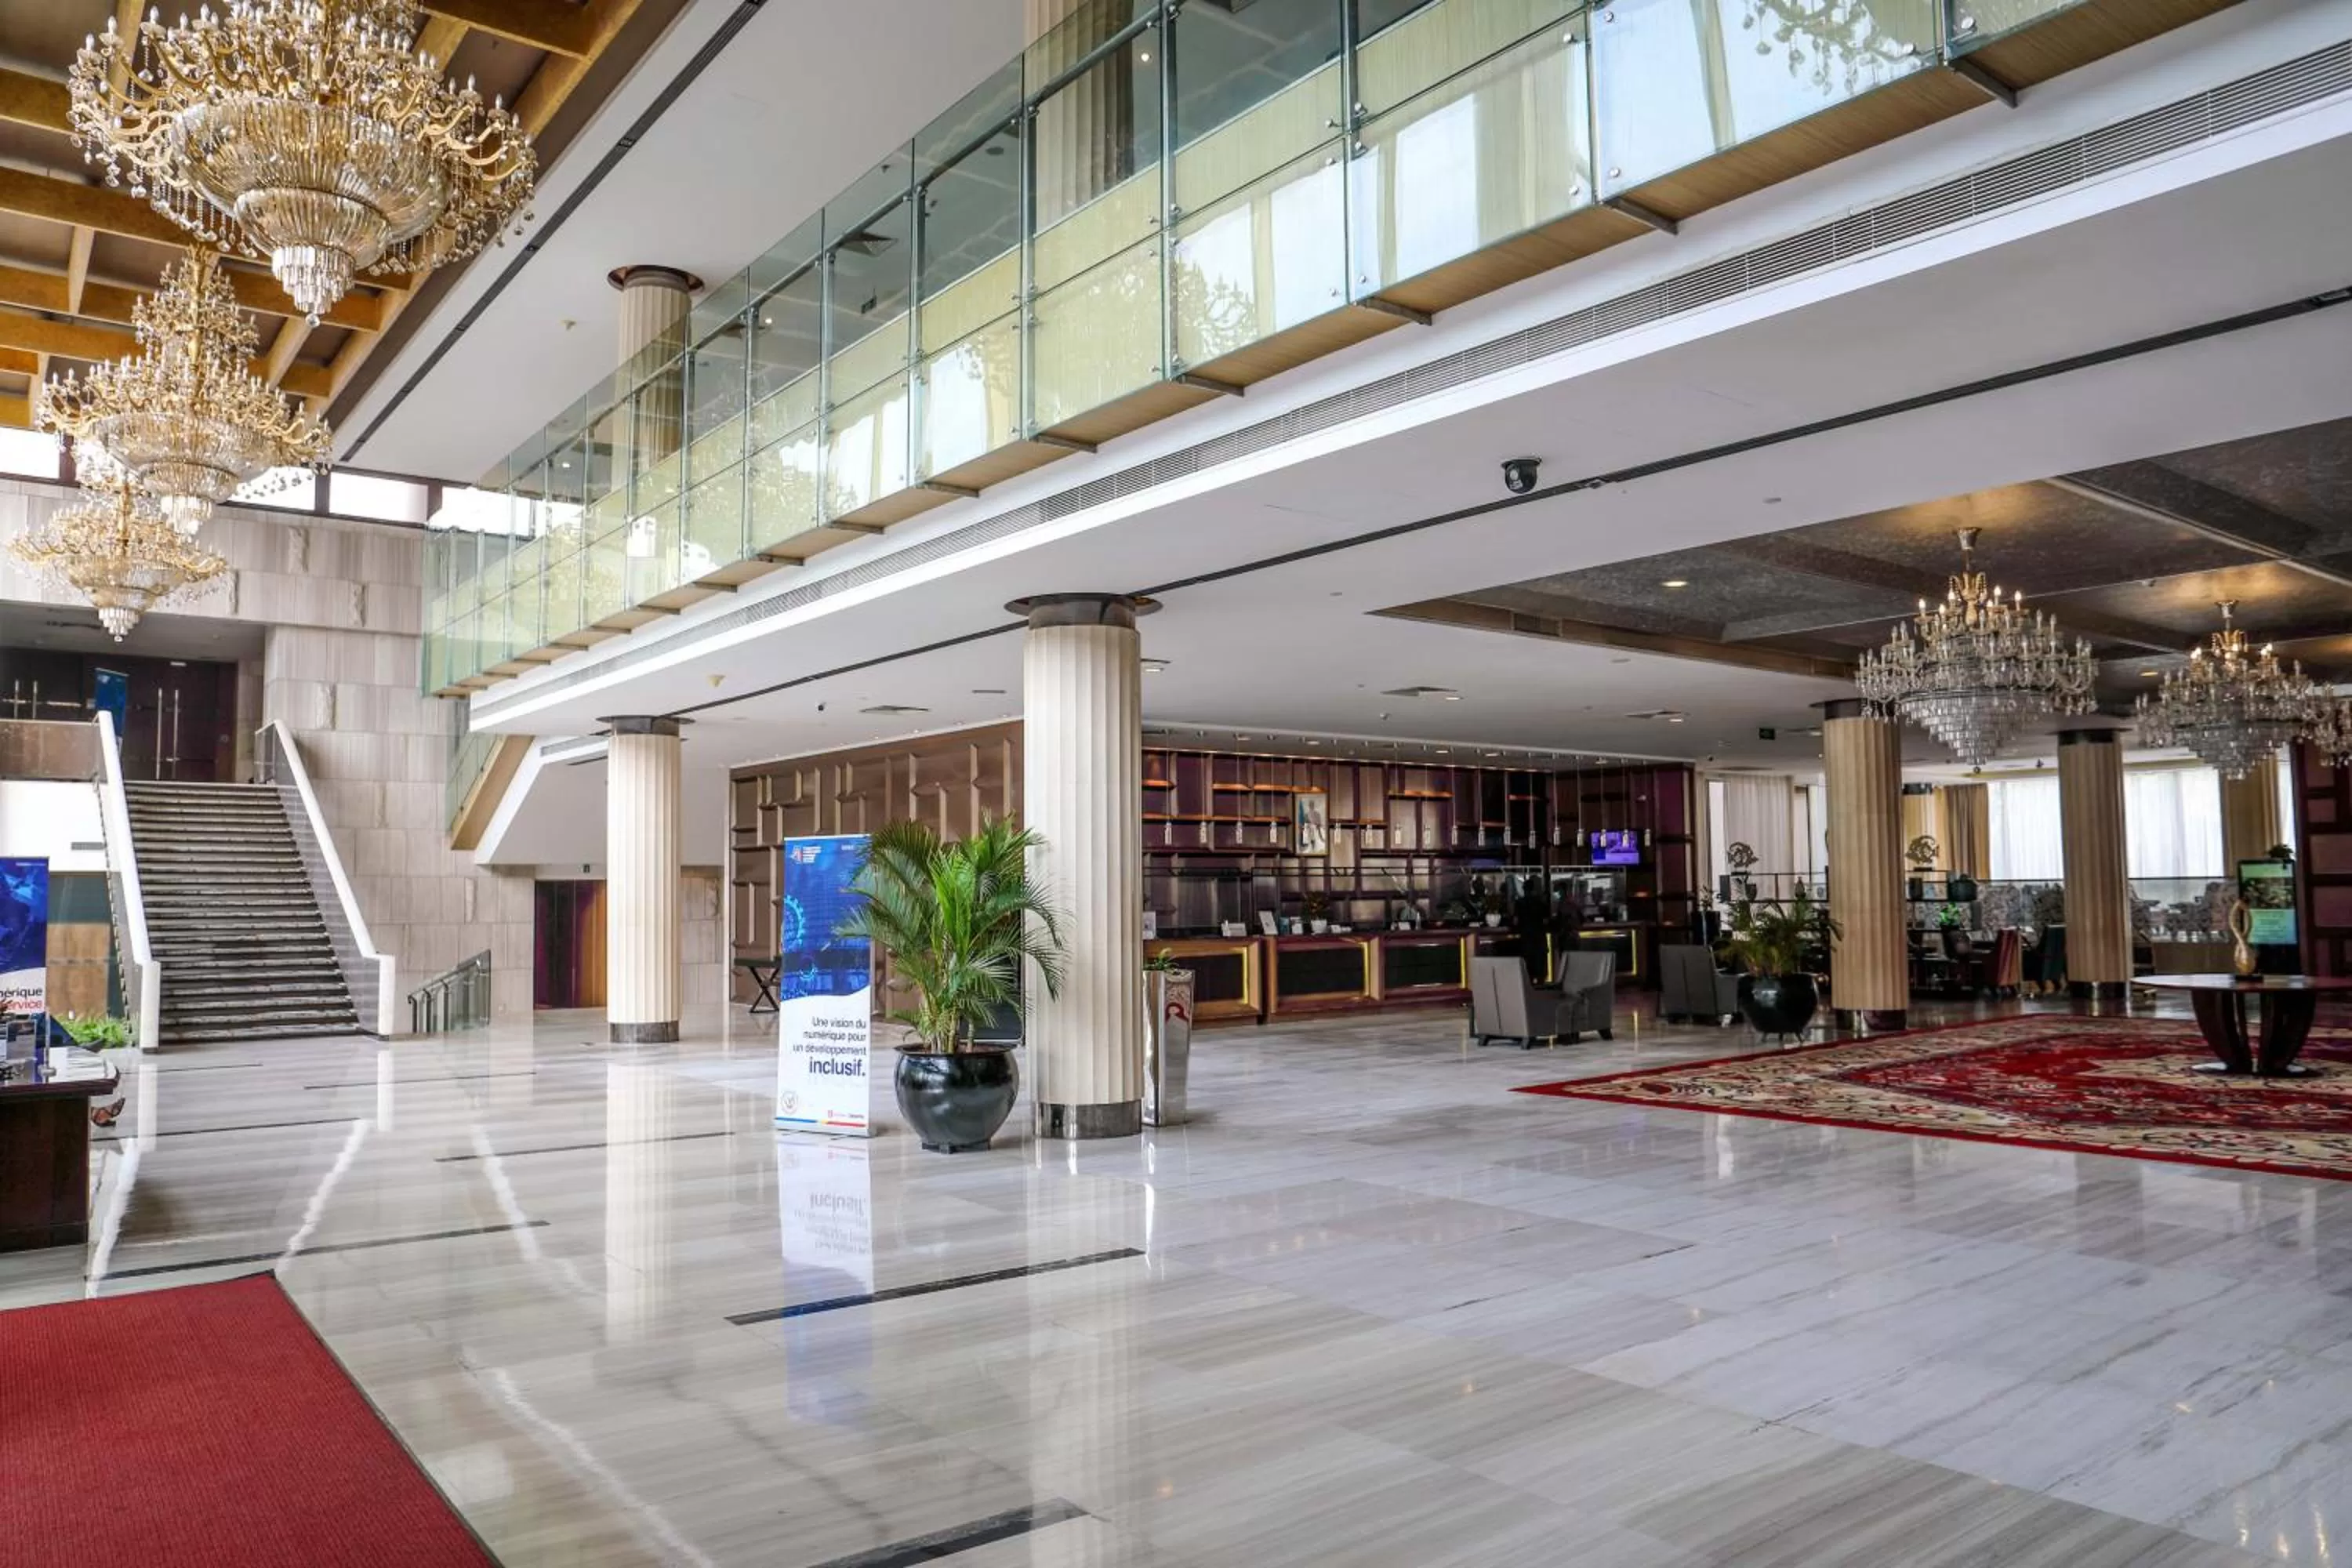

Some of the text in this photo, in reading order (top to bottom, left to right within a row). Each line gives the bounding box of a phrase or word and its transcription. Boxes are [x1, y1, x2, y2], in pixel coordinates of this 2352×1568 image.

[2, 1000, 43, 1010] ervice
[812, 1016, 866, 1029] Une vision du
[848, 1032, 866, 1043] pour
[809, 1056, 866, 1076] inclusif.
